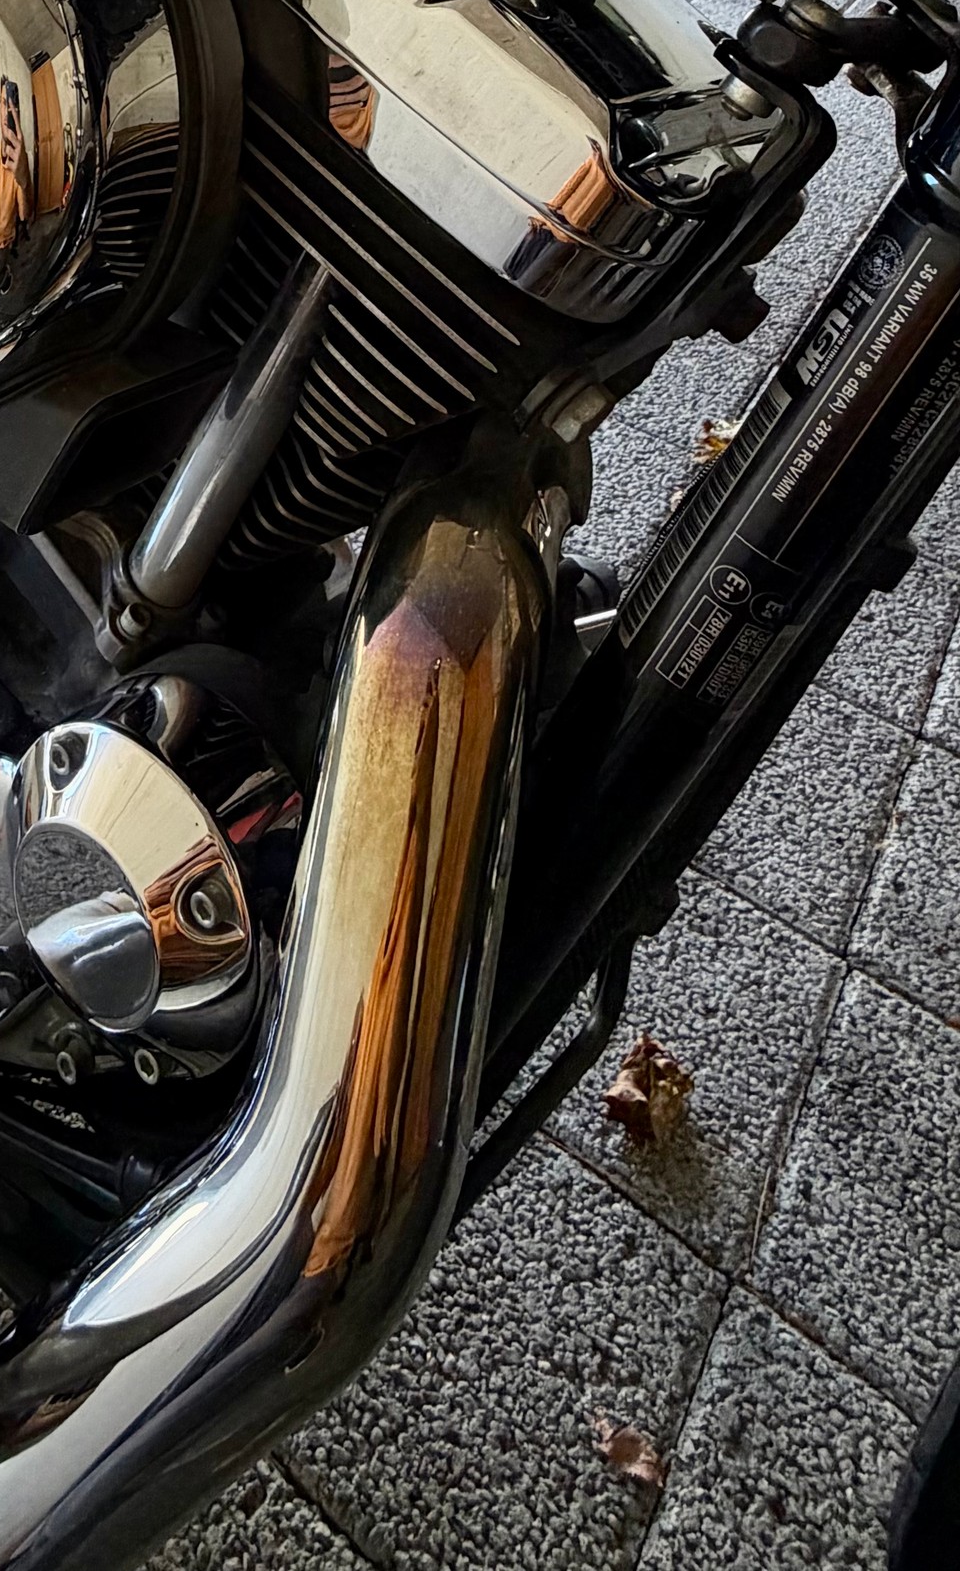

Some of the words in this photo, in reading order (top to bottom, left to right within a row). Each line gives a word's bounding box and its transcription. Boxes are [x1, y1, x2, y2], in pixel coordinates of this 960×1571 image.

[919, 263, 938, 283] 35
[904, 280, 927, 305] kW
[796, 307, 852, 386] USW
[866, 304, 913, 363] VARIANT
[854, 361, 873, 379] 98
[828, 377, 859, 414] dB(A)
[806, 419, 832, 451] 2875
[771, 448, 814, 503] REV/MIN
[705, 611, 729, 638] 78R
[677, 633, 712, 681] 030121
